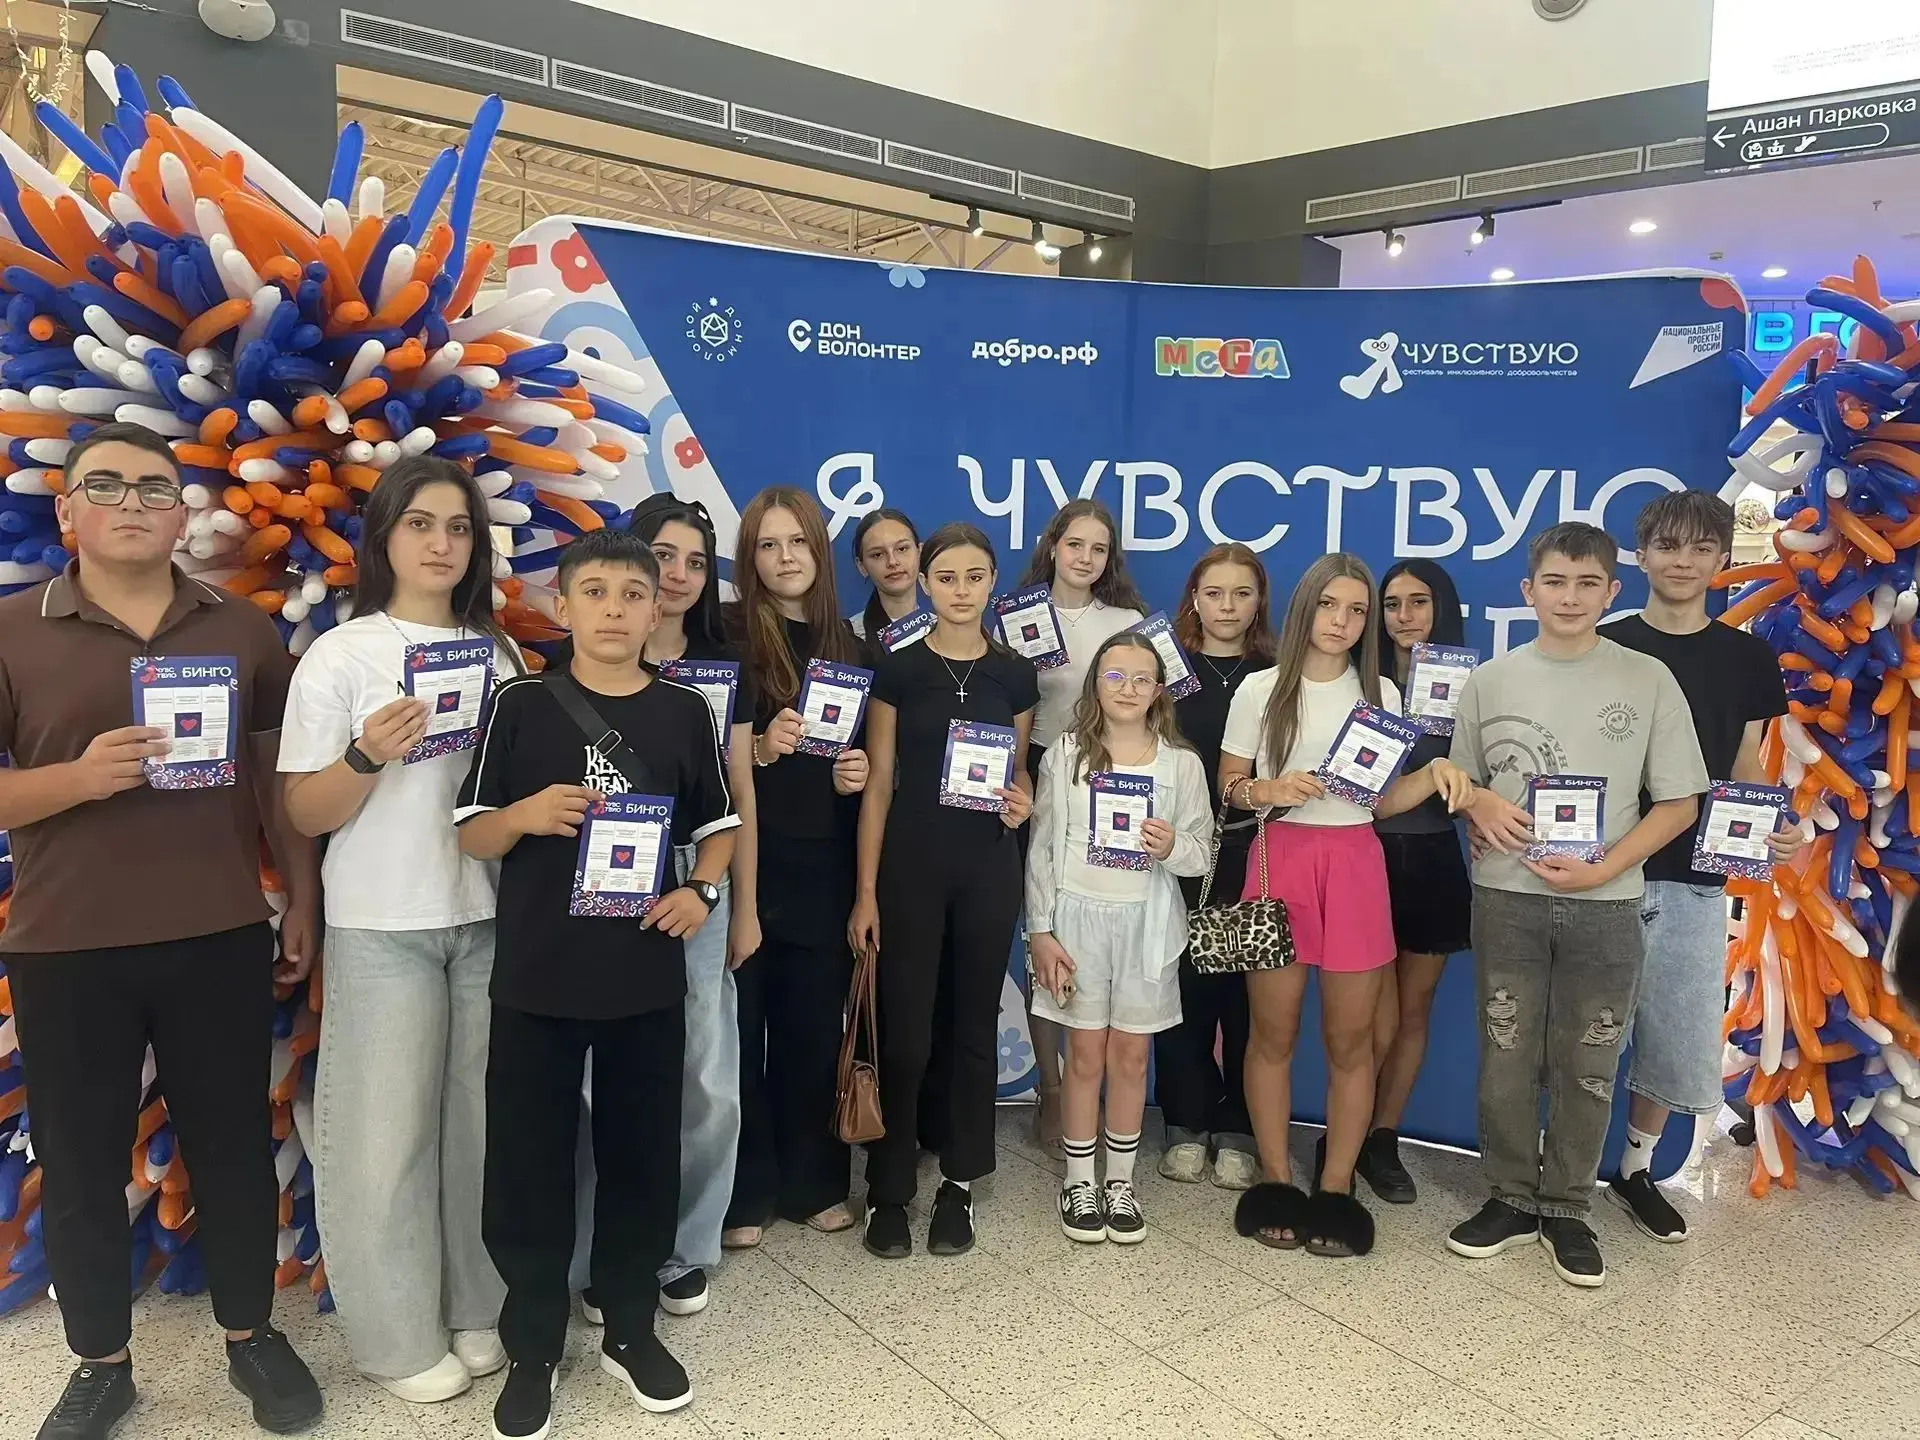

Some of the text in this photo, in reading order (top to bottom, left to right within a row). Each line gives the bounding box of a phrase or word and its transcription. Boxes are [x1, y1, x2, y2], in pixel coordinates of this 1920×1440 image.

[1742, 97, 1917, 135] Ашан Парковка
[818, 322, 861, 340] ДОН
[1663, 323, 1722, 336] НАЦИОНАЛЬНЫЕ
[1687, 333, 1721, 344] ПРОЕКТЫ
[818, 340, 921, 360] ВОЛОНТЕР
[972, 337, 1098, 366] добро.рф
[1401, 342, 1579, 364] ЧУВСТВУЮ
[1693, 342, 1720, 352] РОССИИ
[816, 452, 1688, 565] Я ЧУВСТВУЮ
[1019, 589, 1047, 604] БИНГО
[902, 613, 928, 631] БИНГО
[447, 647, 489, 661] БИНГО
[1442, 652, 1475, 663] БИНГО
[182, 667, 231, 678] БИНГО
[696, 668, 734, 679] БИНГО
[837, 671, 869, 686] БИНГО
[1382, 719, 1416, 740] БИНГО
[980, 731, 1014, 743] БИНГО
[1118, 780, 1150, 791] БИНГО
[1745, 790, 1784, 802] БИНГО
[625, 803, 668, 816] БИНГО
